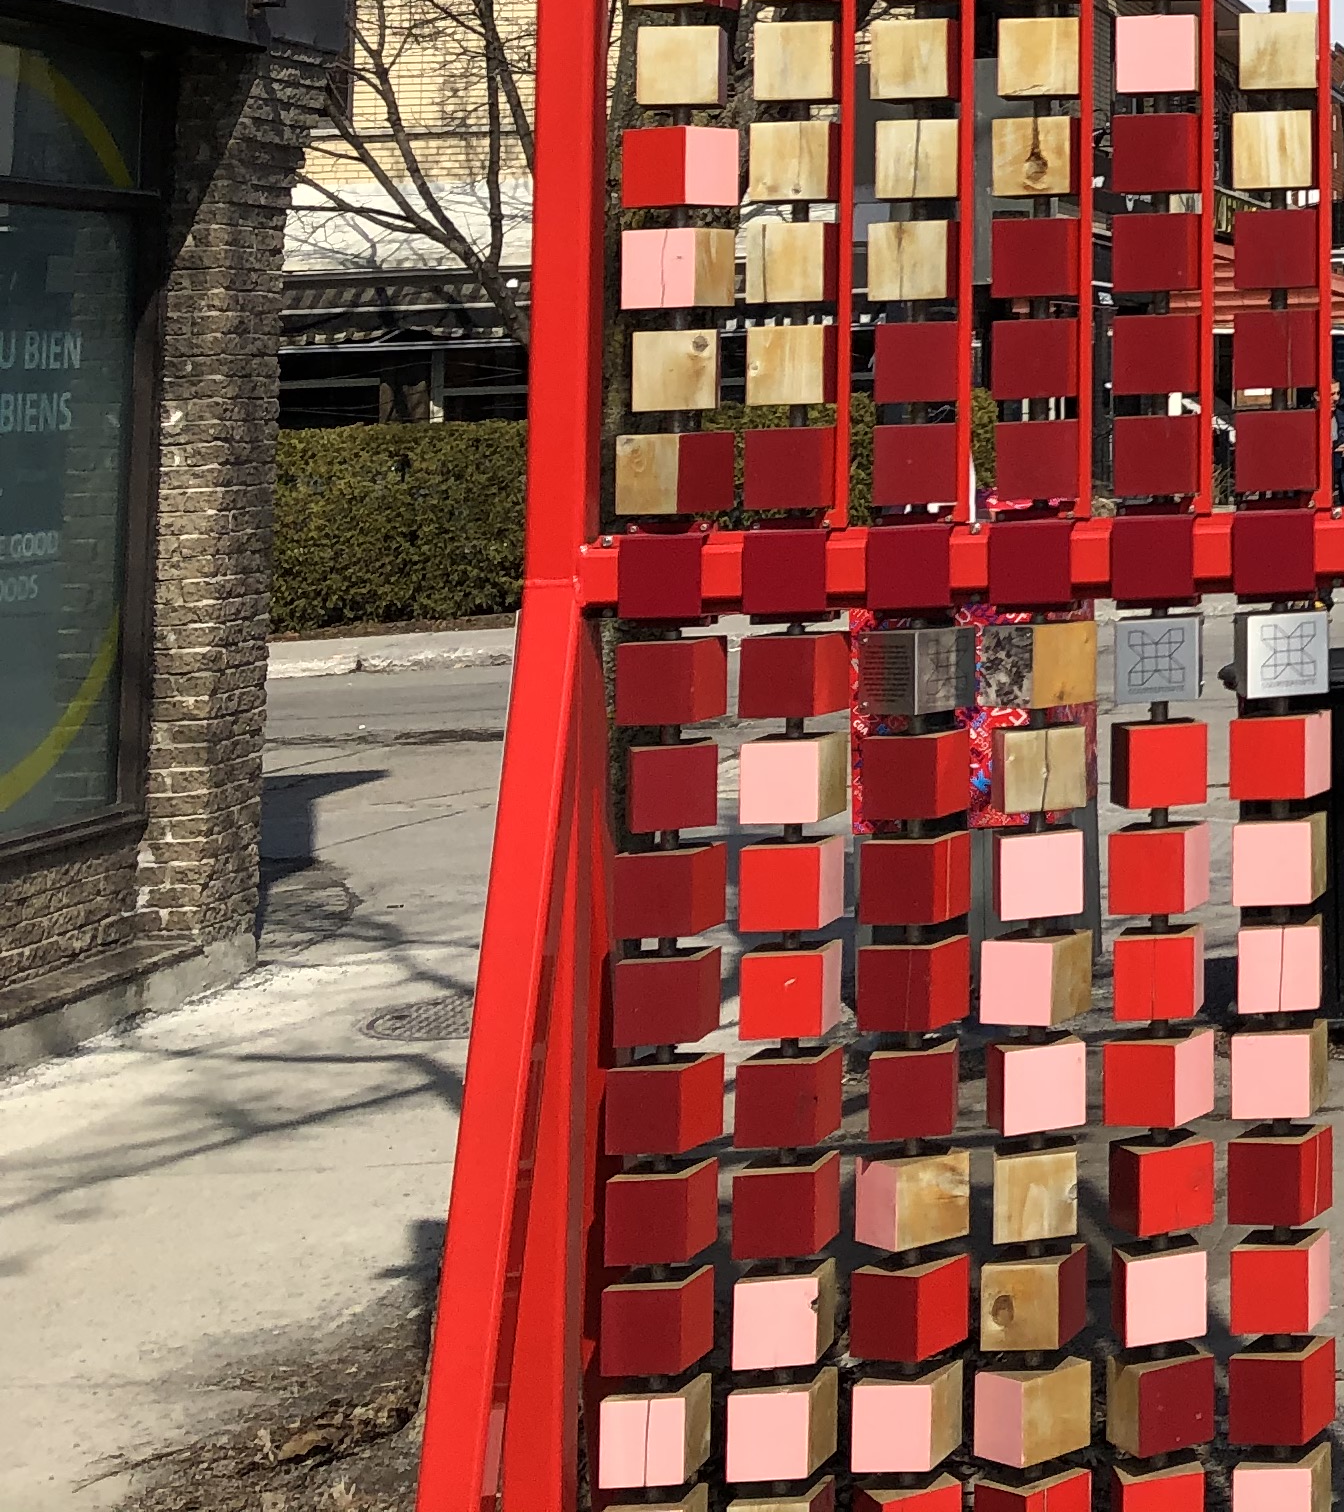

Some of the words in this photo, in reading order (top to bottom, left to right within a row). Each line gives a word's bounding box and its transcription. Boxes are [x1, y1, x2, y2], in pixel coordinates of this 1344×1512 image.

[24, 330, 82, 369] BIEN
[0, 391, 72, 431] BIENS
[11, 530, 59, 558] GOOD
